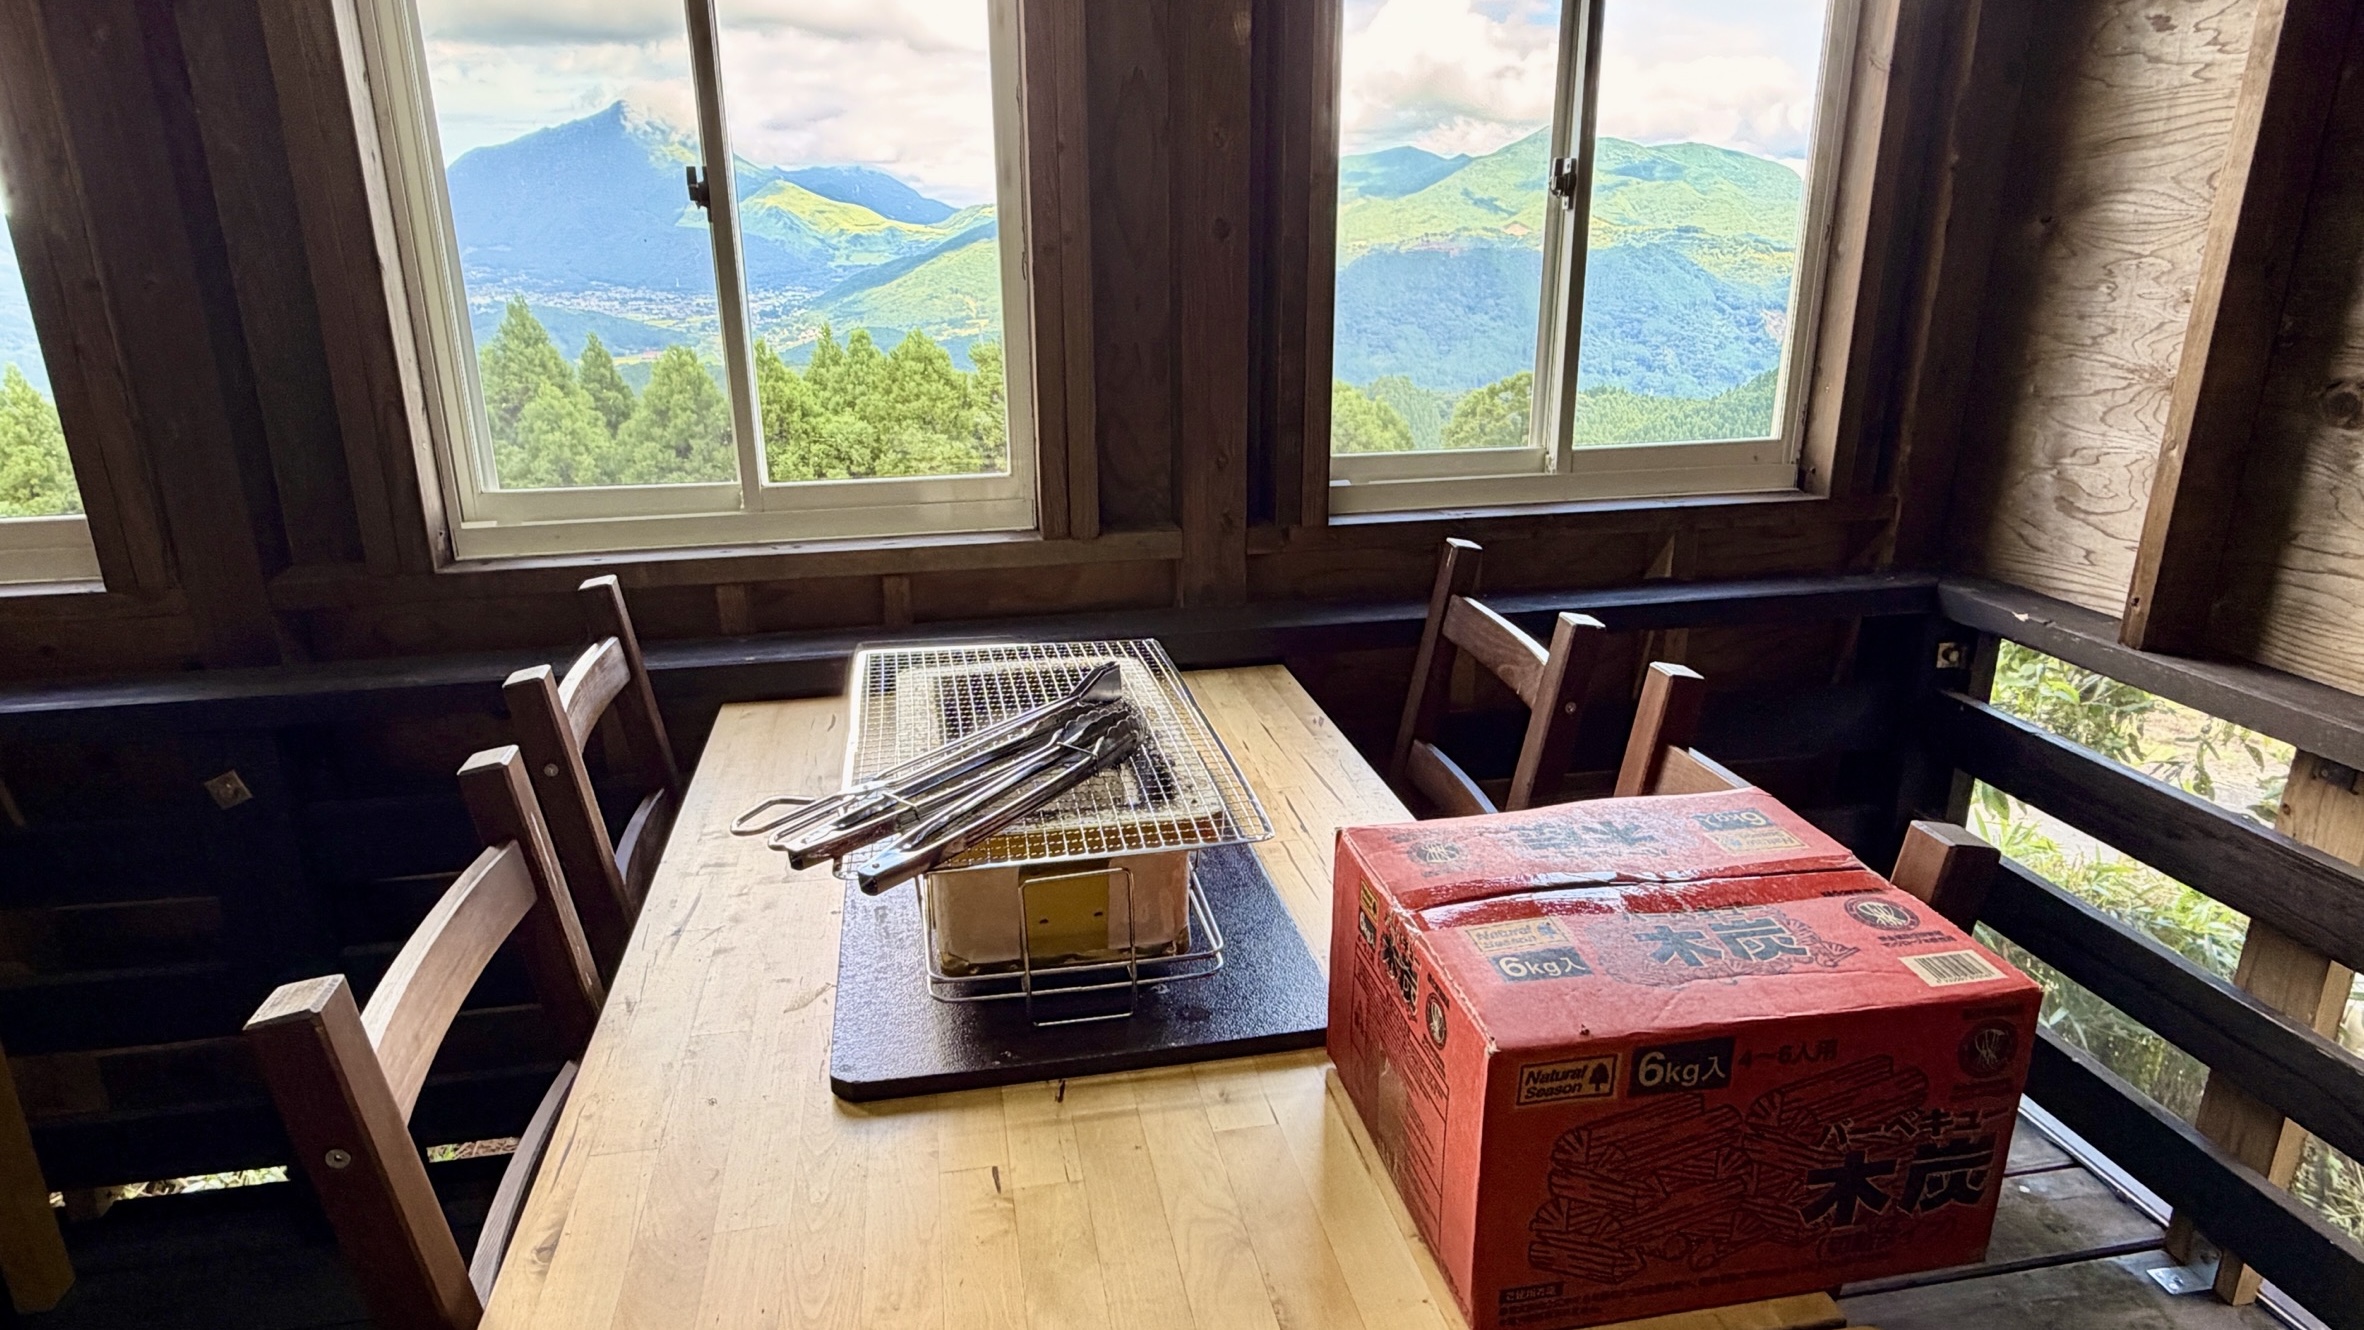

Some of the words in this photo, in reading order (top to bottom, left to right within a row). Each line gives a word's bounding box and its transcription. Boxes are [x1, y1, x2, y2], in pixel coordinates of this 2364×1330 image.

[1475, 924, 1532, 941] Natural
[1634, 916, 1811, 968] 木炭
[1498, 956, 1587, 977] 6kg入
[1524, 1065, 1589, 1086] Natural
[1637, 1051, 1727, 1088] 6kg入
[1524, 1081, 1583, 1100] Season
[1813, 1106, 2011, 1151] バーベキュー
[1799, 1131, 1999, 1227] 木炭
